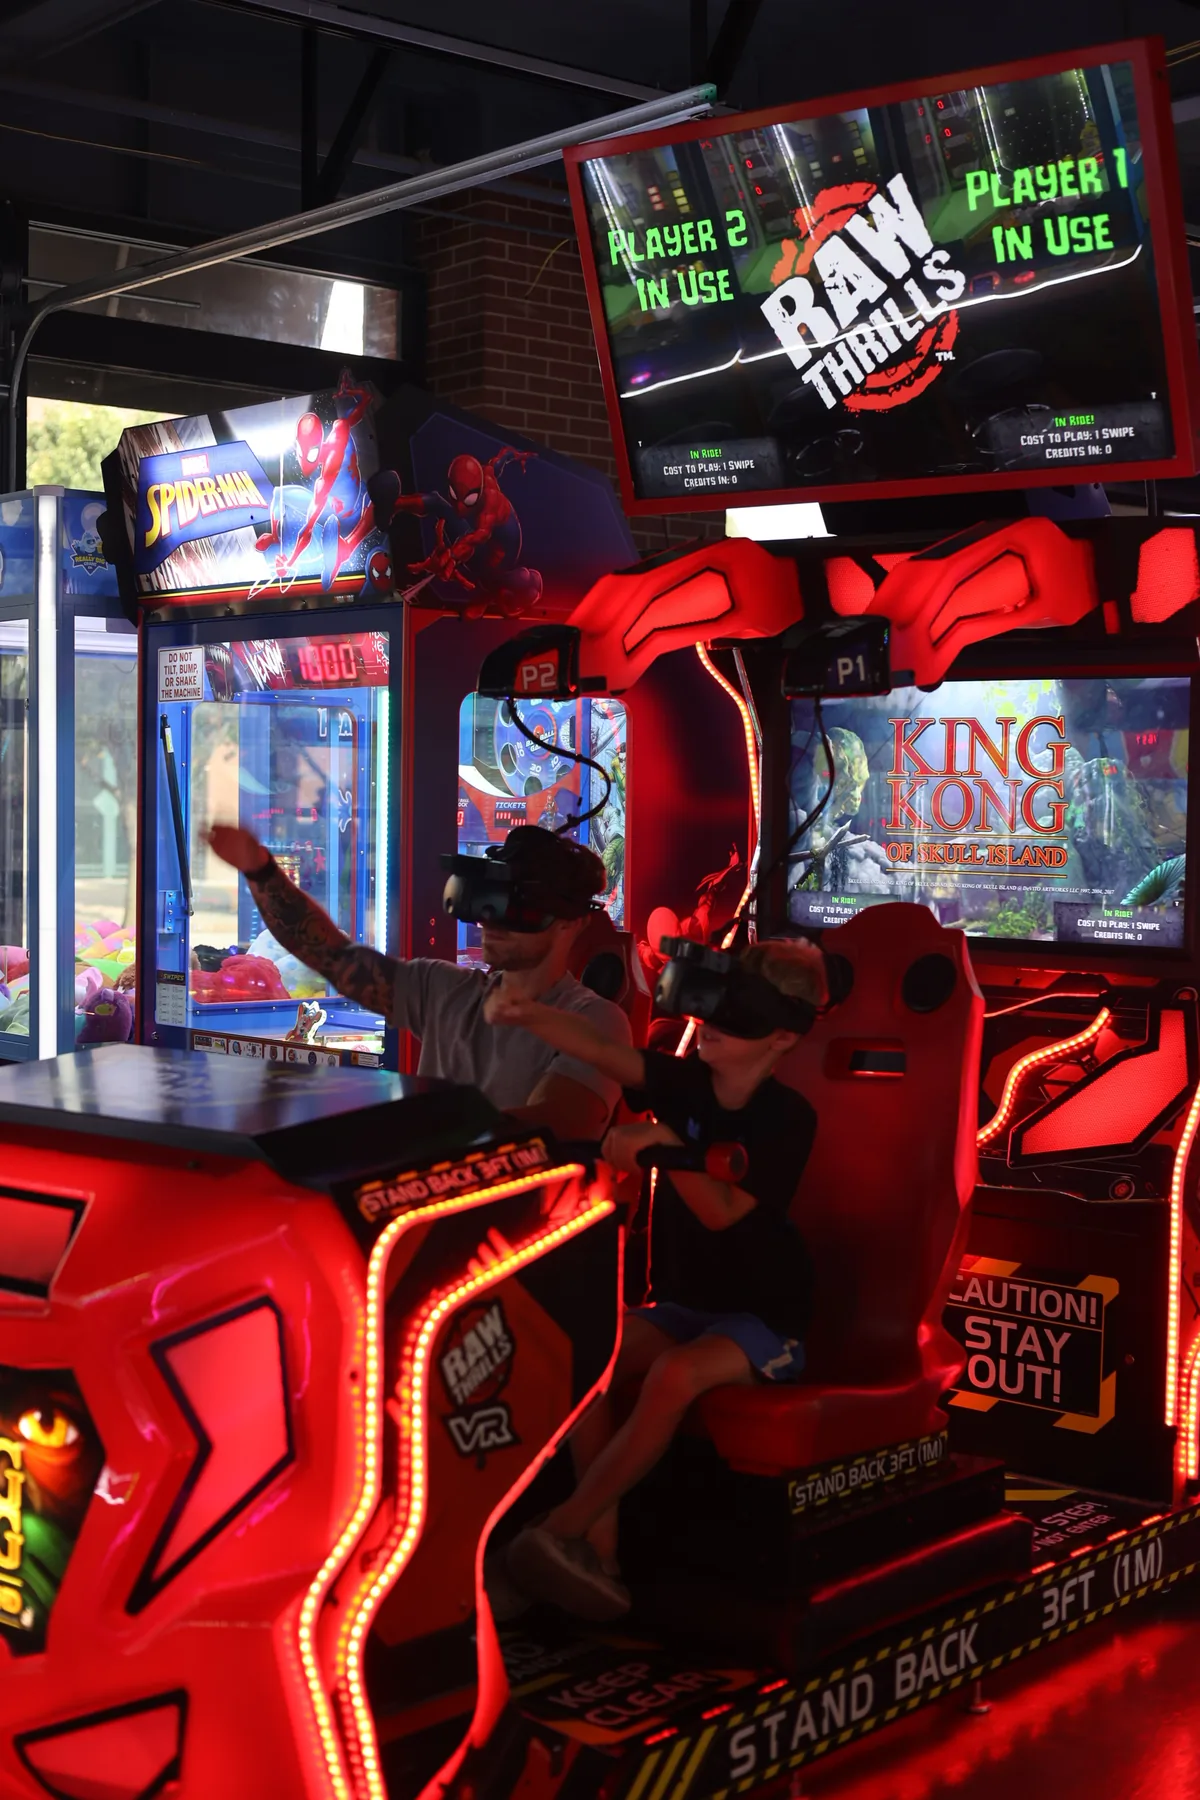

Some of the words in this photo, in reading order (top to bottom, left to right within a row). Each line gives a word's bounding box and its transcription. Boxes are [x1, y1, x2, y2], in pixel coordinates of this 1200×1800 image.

[965, 156, 1103, 211] PLAYER
[1112, 147, 1129, 188] 1
[607, 219, 718, 266] PLAYER
[725, 209, 748, 247] 2
[992, 224, 1034, 264] IN
[1044, 213, 1115, 256] USE
[760, 172, 934, 370] RAW
[636, 278, 670, 311] IN
[677, 269, 735, 306] USE
[801, 250, 966, 410] THRILLS
[1054, 416, 1067, 427] IN
[1069, 414, 1095, 426] RIDE!
[1020, 434, 1045, 446] COST
[1047, 432, 1061, 443] TO
[1064, 431, 1093, 442] PLAY:
[1102, 427, 1135, 439] SWIPE
[1045, 446, 1085, 459] CREDITS
[1088, 444, 1103, 456] IN:
[1105, 444, 1112, 454] 0
[663, 466, 683, 476] COST
[685, 464, 697, 474] TO
[698, 462, 721, 473] PLAY:
[728, 460, 755, 470] SWIPE
[689, 450, 700, 459] IN
[701, 448, 722, 459] RIDE!
[684, 476, 717, 487] CREDITS
[718, 475, 730, 485] IN:
[732, 475, 738, 484] 0
[145, 470, 269, 548] SPIDER-MAN
[164, 664, 178, 675] TILT,
[179, 663, 199, 674] BUMP,
[168, 653, 178, 663] DO
[179, 651, 193, 662] NOT
[244, 639, 287, 691] VENOM
[837, 654, 866, 685] P1
[165, 677, 174, 687] OR
[175, 675, 197, 686] SHAKE
[521, 662, 557, 690] P2
[161, 689, 173, 699] THE
[173, 687, 201, 698] MACHINE
[887, 715, 1072, 779] KING
[495, 801, 527, 809] TICKETS
[885, 777, 1069, 834] KONG
[886, 842, 913, 862] OF
[917, 843, 985, 866] SKULL
[986, 845, 1068, 868] ISLAND
[809, 905, 824, 913] COST
[826, 906, 835, 914] TO
[836, 906, 854, 915] PLAY:
[831, 896, 839, 904] IN
[840, 897, 857, 905] RIDE!
[1104, 909, 1112, 917] IN
[1114, 909, 1133, 918] RIDE!
[1077, 918, 1095, 927] COST
[1098, 920, 1107, 928] TO
[1109, 920, 1130, 929] PLAY:
[1136, 922, 1160, 931] SWIPE
[1094, 930, 1123, 939] CREDITS
[1124, 932, 1136, 940] IN:
[360, 1179, 429, 1213] STAND
[426, 1165, 480, 1194] BACK
[475, 1154, 513, 1180] 3FT
[441, 1304, 504, 1388] RAW
[964, 1315, 1072, 1365] STAY
[967, 1354, 1061, 1403] OUT!
[448, 1406, 513, 1453] VR
[795, 1471, 846, 1506] STAND
[849, 1458, 886, 1487] BACK
[889, 1448, 914, 1473] 3FT
[917, 1438, 943, 1464] (1M)
[1041, 1501, 1109, 1528] STEP!
[729, 1673, 874, 1780] STAND
[894, 1622, 979, 1700] BACK
[1042, 1569, 1096, 1631] 3FT
[1113, 1537, 1163, 1598] (1M)
[547, 1661, 652, 1709] KEEP
[584, 1671, 721, 1727] CLEAR
